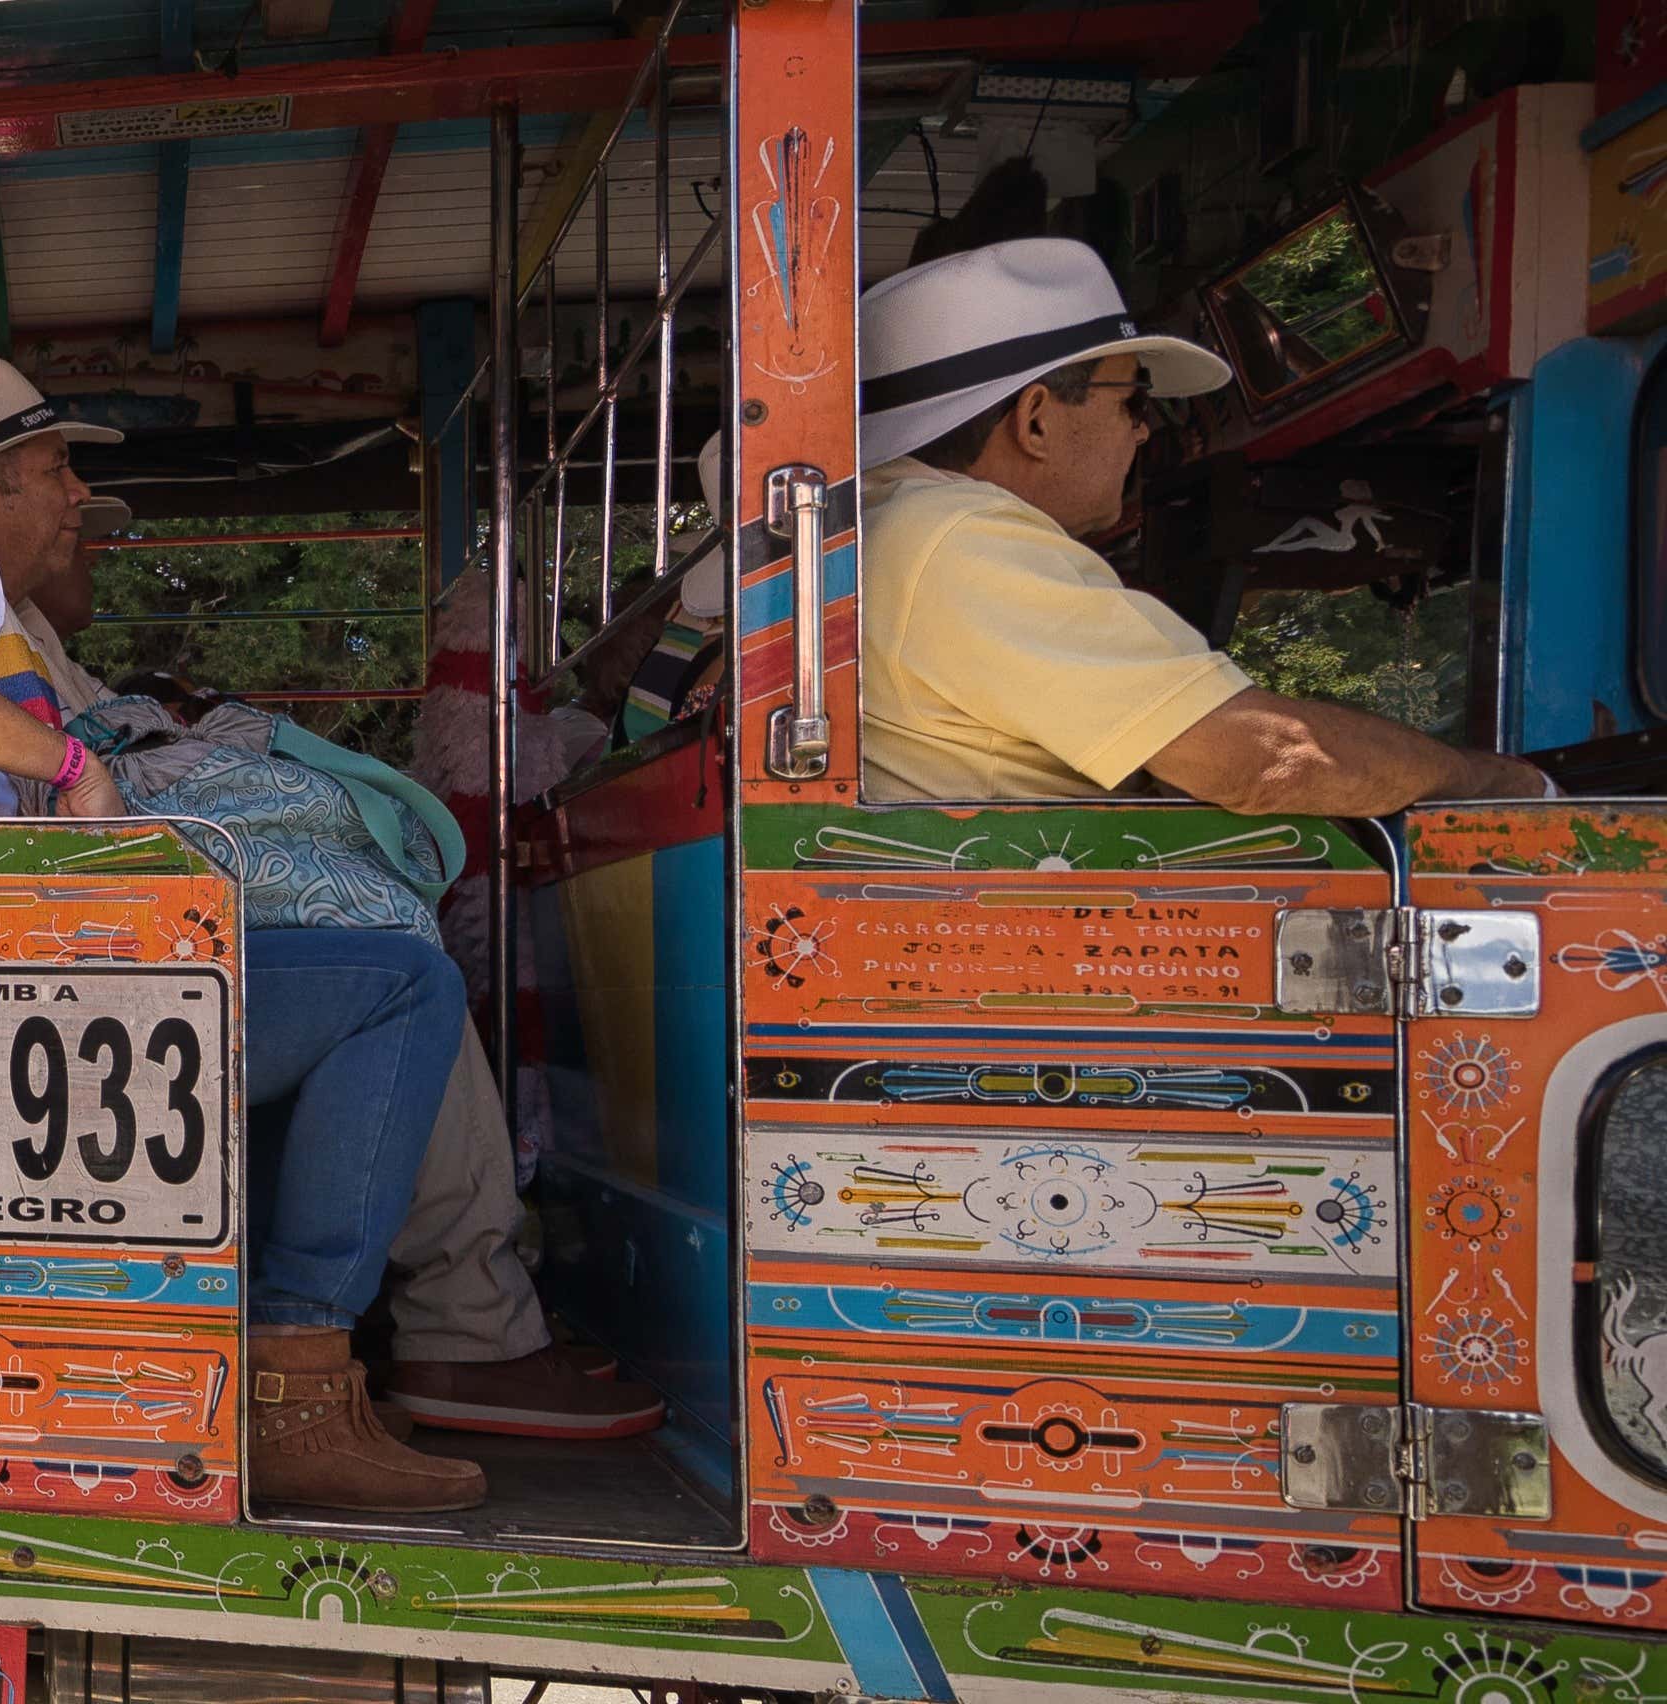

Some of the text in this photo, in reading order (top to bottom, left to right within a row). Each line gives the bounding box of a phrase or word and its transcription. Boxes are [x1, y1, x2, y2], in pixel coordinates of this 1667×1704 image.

[856, 922, 1262, 938] CARROCERIAS EL TRIUNFO
[1083, 944, 1240, 958] ZAPATA
[1073, 962, 1240, 978] PINGÜINO
[10, 1016, 205, 1185] 933
